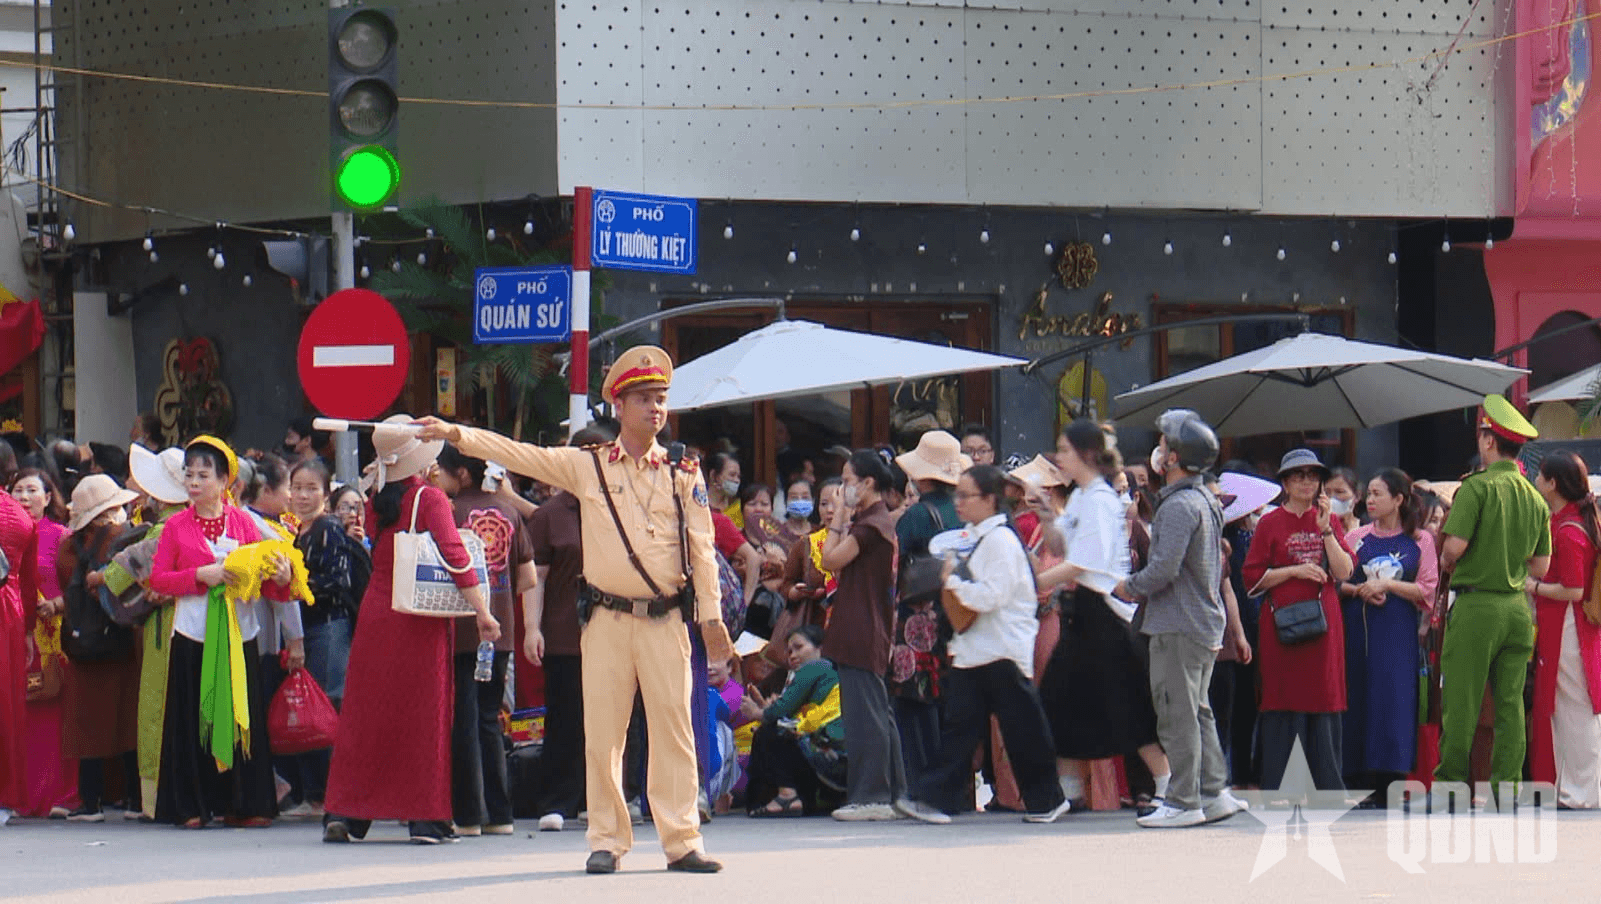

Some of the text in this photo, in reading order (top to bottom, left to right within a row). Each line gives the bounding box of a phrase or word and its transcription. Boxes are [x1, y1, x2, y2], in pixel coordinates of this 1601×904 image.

[632, 204, 664, 222] PHỐ
[600, 226, 686, 266] LÝ THƯỜNG KIỆT
[517, 275, 548, 294] PHỐ
[480, 297, 563, 332] QUÁN SỨ
